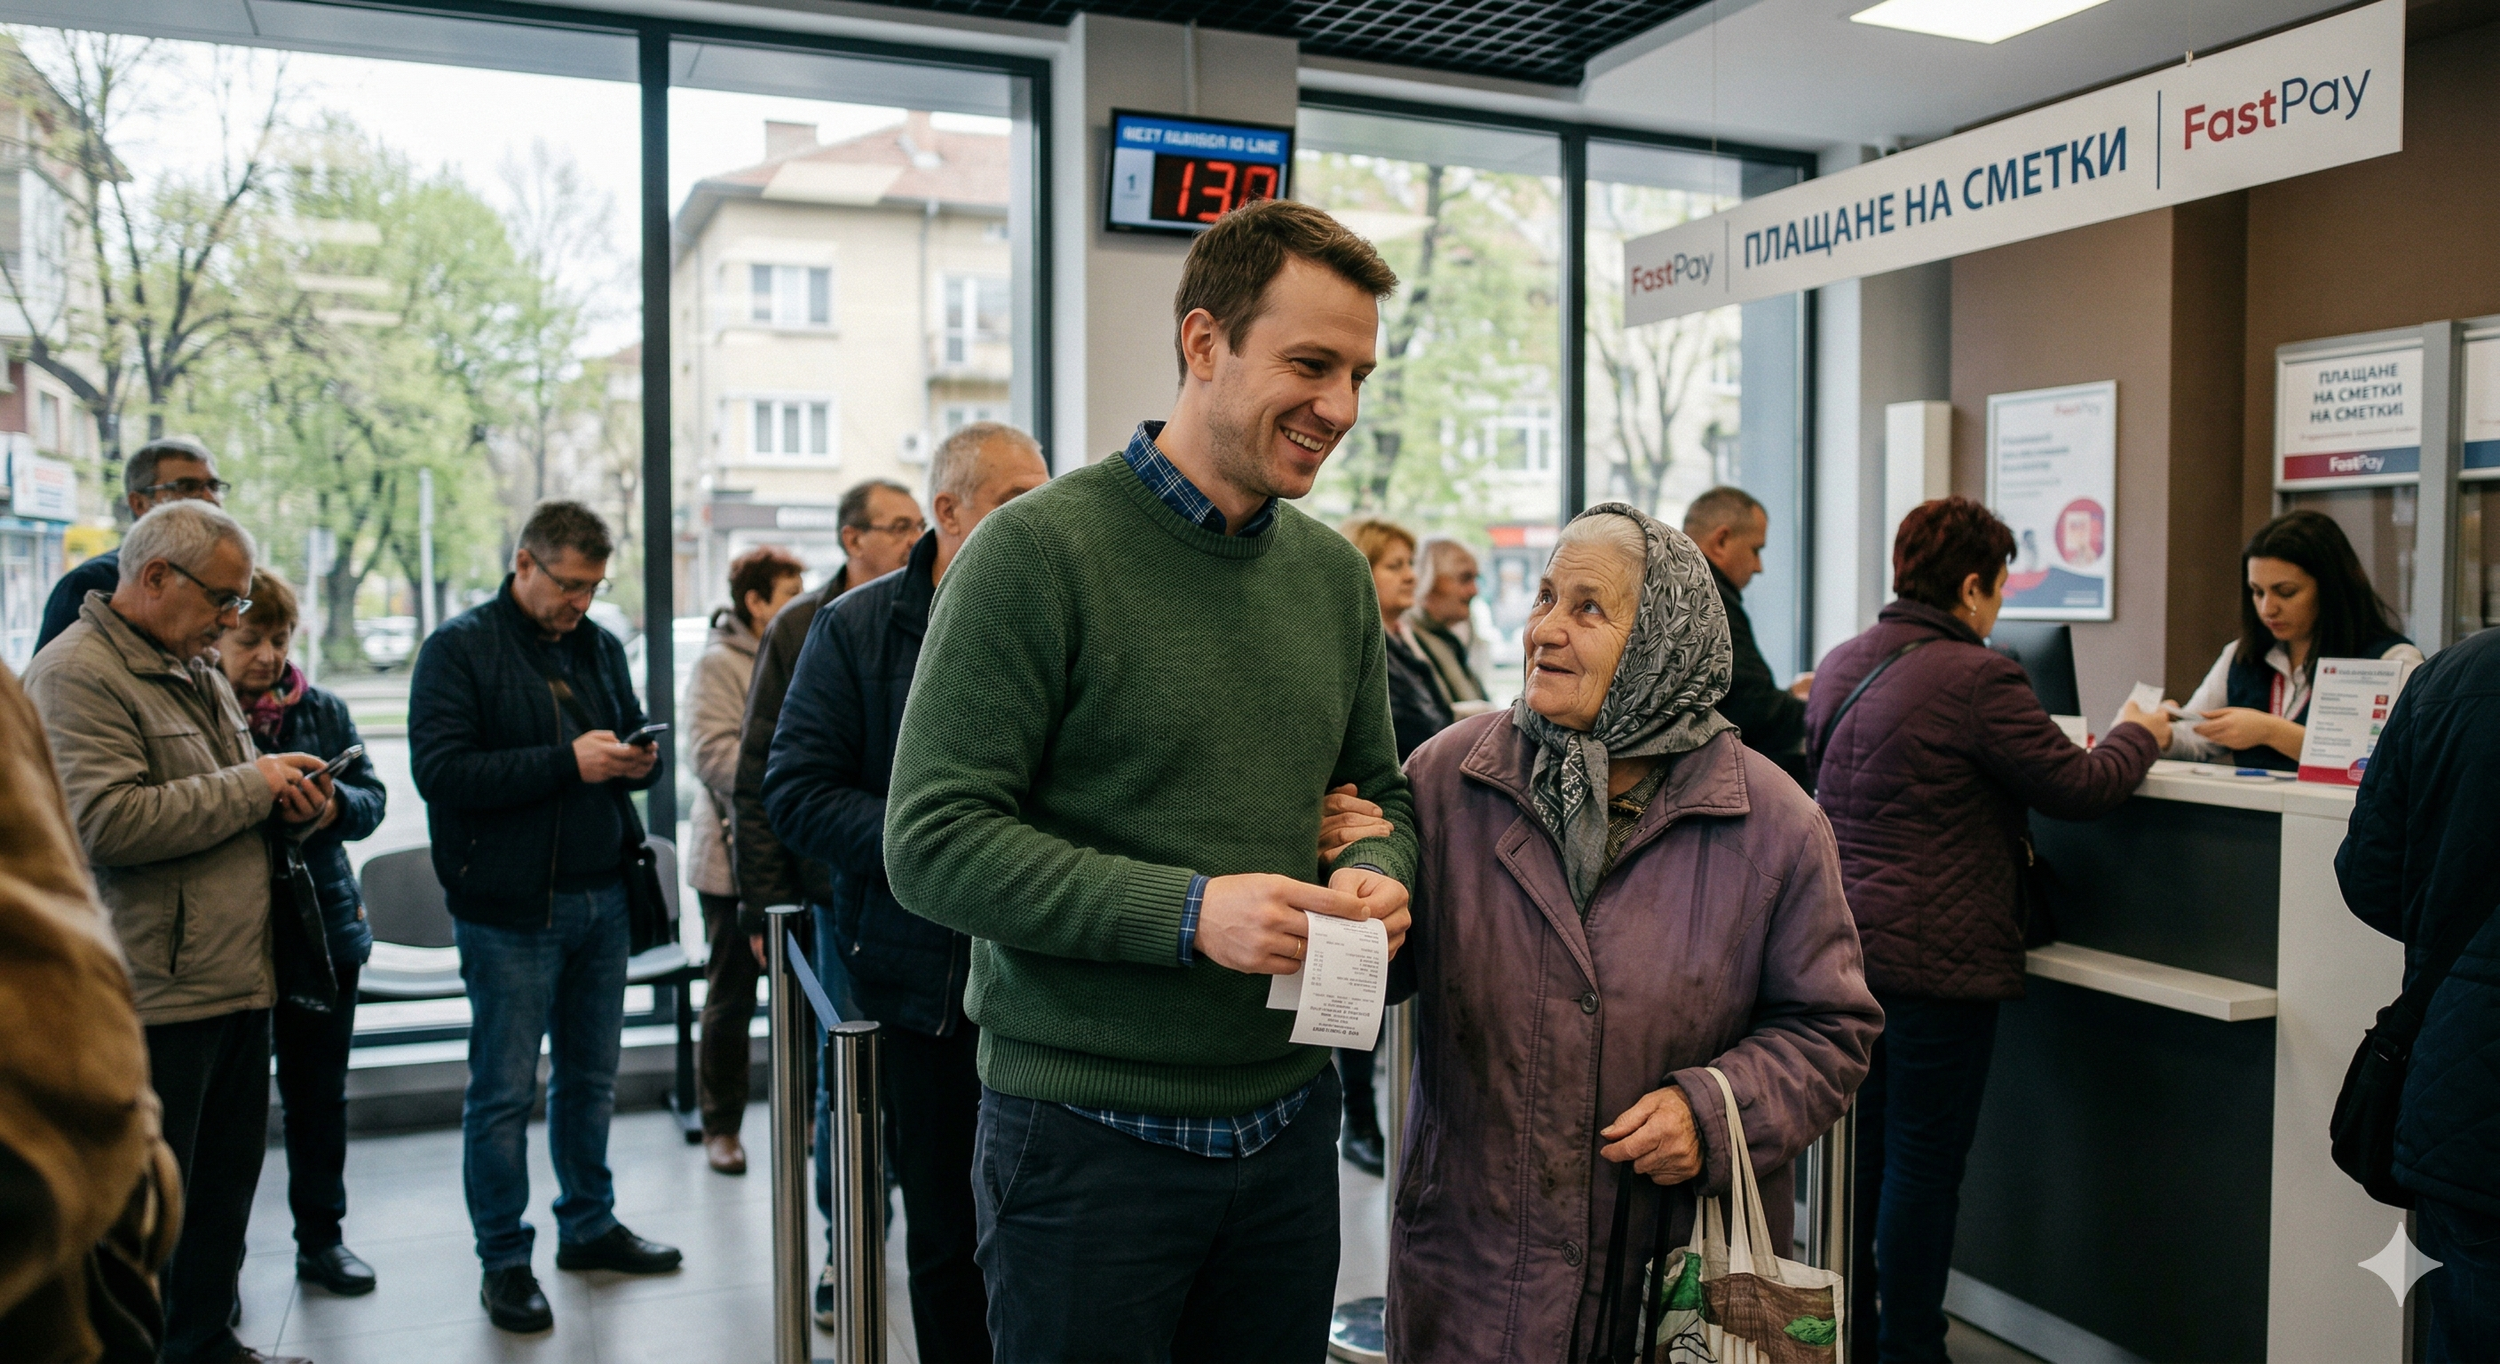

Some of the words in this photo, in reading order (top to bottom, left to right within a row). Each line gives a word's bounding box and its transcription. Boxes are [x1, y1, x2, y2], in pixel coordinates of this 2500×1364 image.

[2184, 68, 2371, 150] FastPay
[1127, 173, 1136, 190] 1
[1745, 192, 1895, 269] ПЛАЩАНЕ
[1906, 178, 1952, 226] НА
[1963, 126, 2127, 211] СМЕТКИ
[1631, 252, 1714, 296] FastPay
[2319, 363, 2398, 384] ПЛАЩАНЕ
[2314, 390, 2335, 404] НА
[2338, 382, 2403, 402] СМЕТКИ
[2310, 408, 2332, 423] НА
[2328, 454, 2385, 473] FastPay
